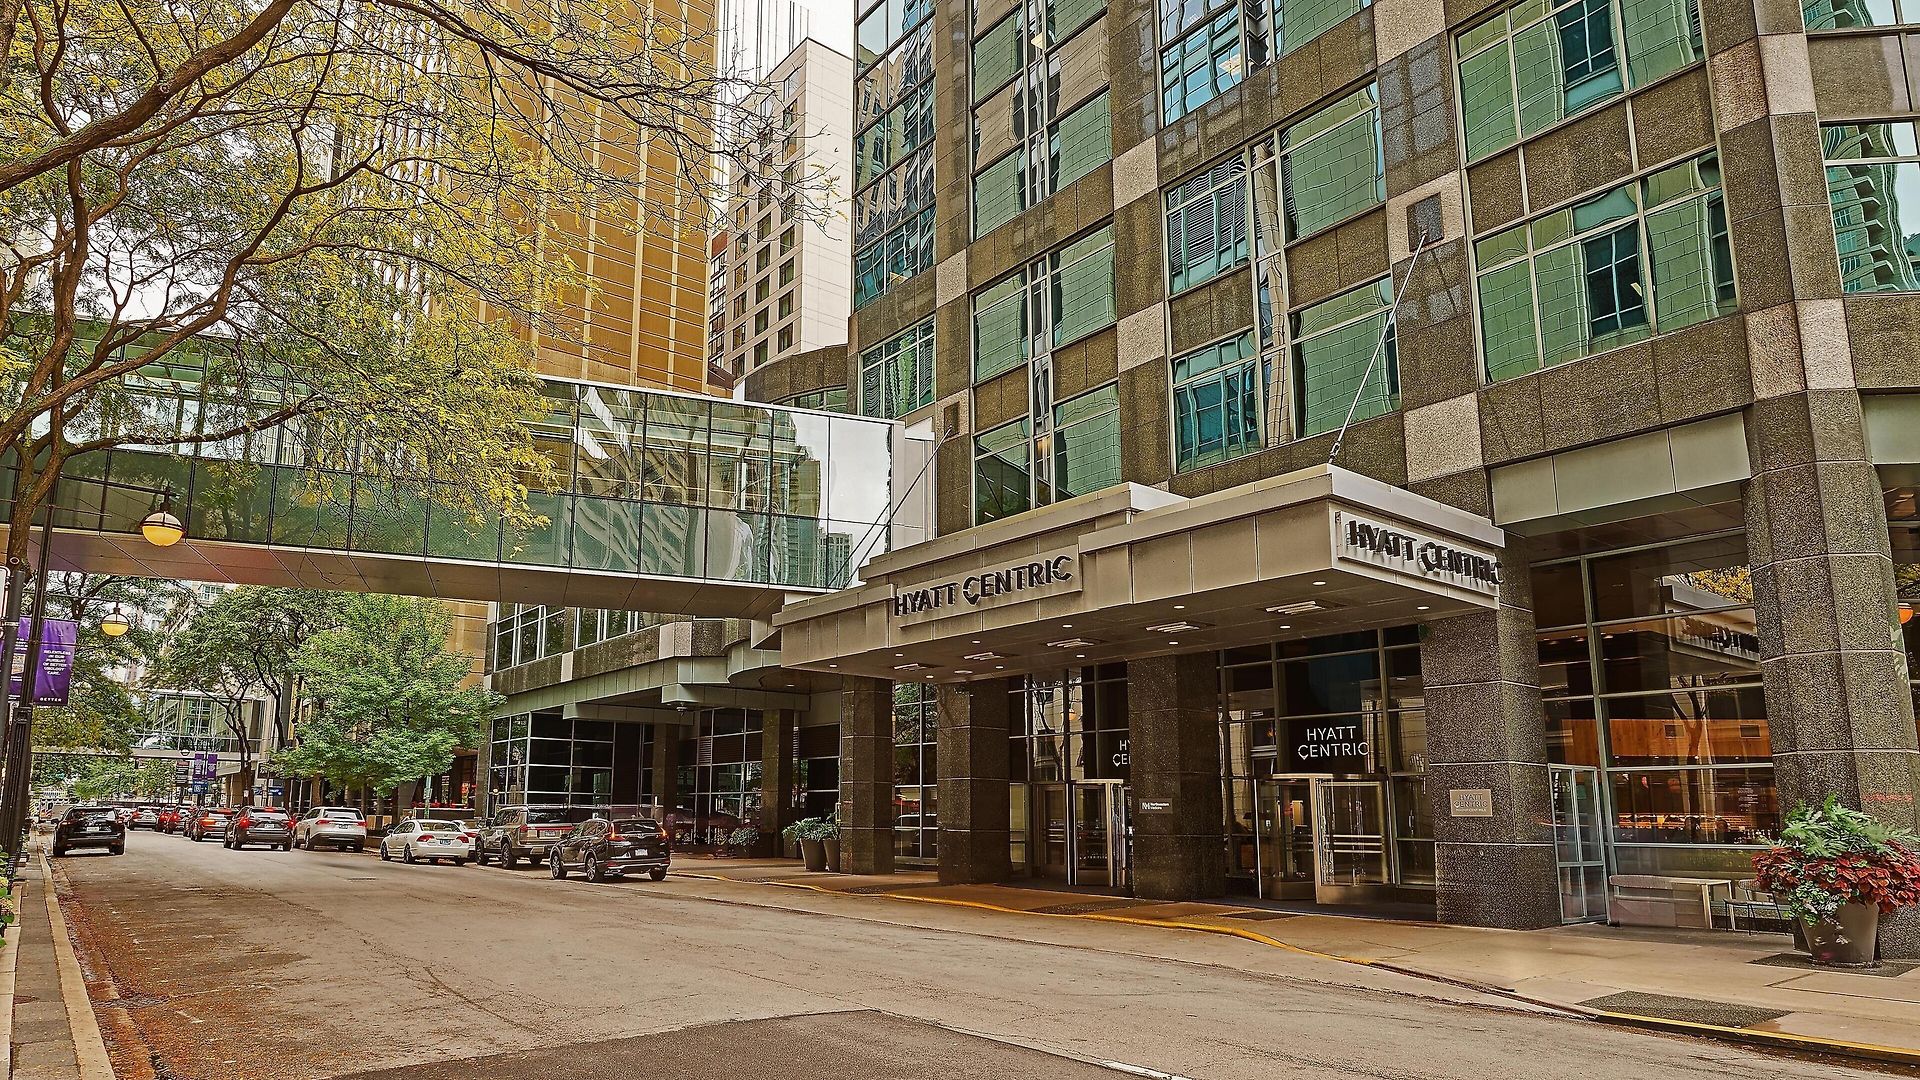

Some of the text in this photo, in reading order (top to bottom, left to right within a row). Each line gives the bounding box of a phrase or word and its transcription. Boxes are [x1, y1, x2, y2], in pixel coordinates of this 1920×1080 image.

[1347, 520, 1504, 585] HYATT CENTRIC
[894, 555, 1073, 616] HYATT CENTRIC
[1306, 725, 1357, 741] HYATT
[1297, 742, 1369, 761] CENTRIC
[1453, 800, 1489, 808] CENTRIC
[1459, 792, 1483, 800] HYATT
